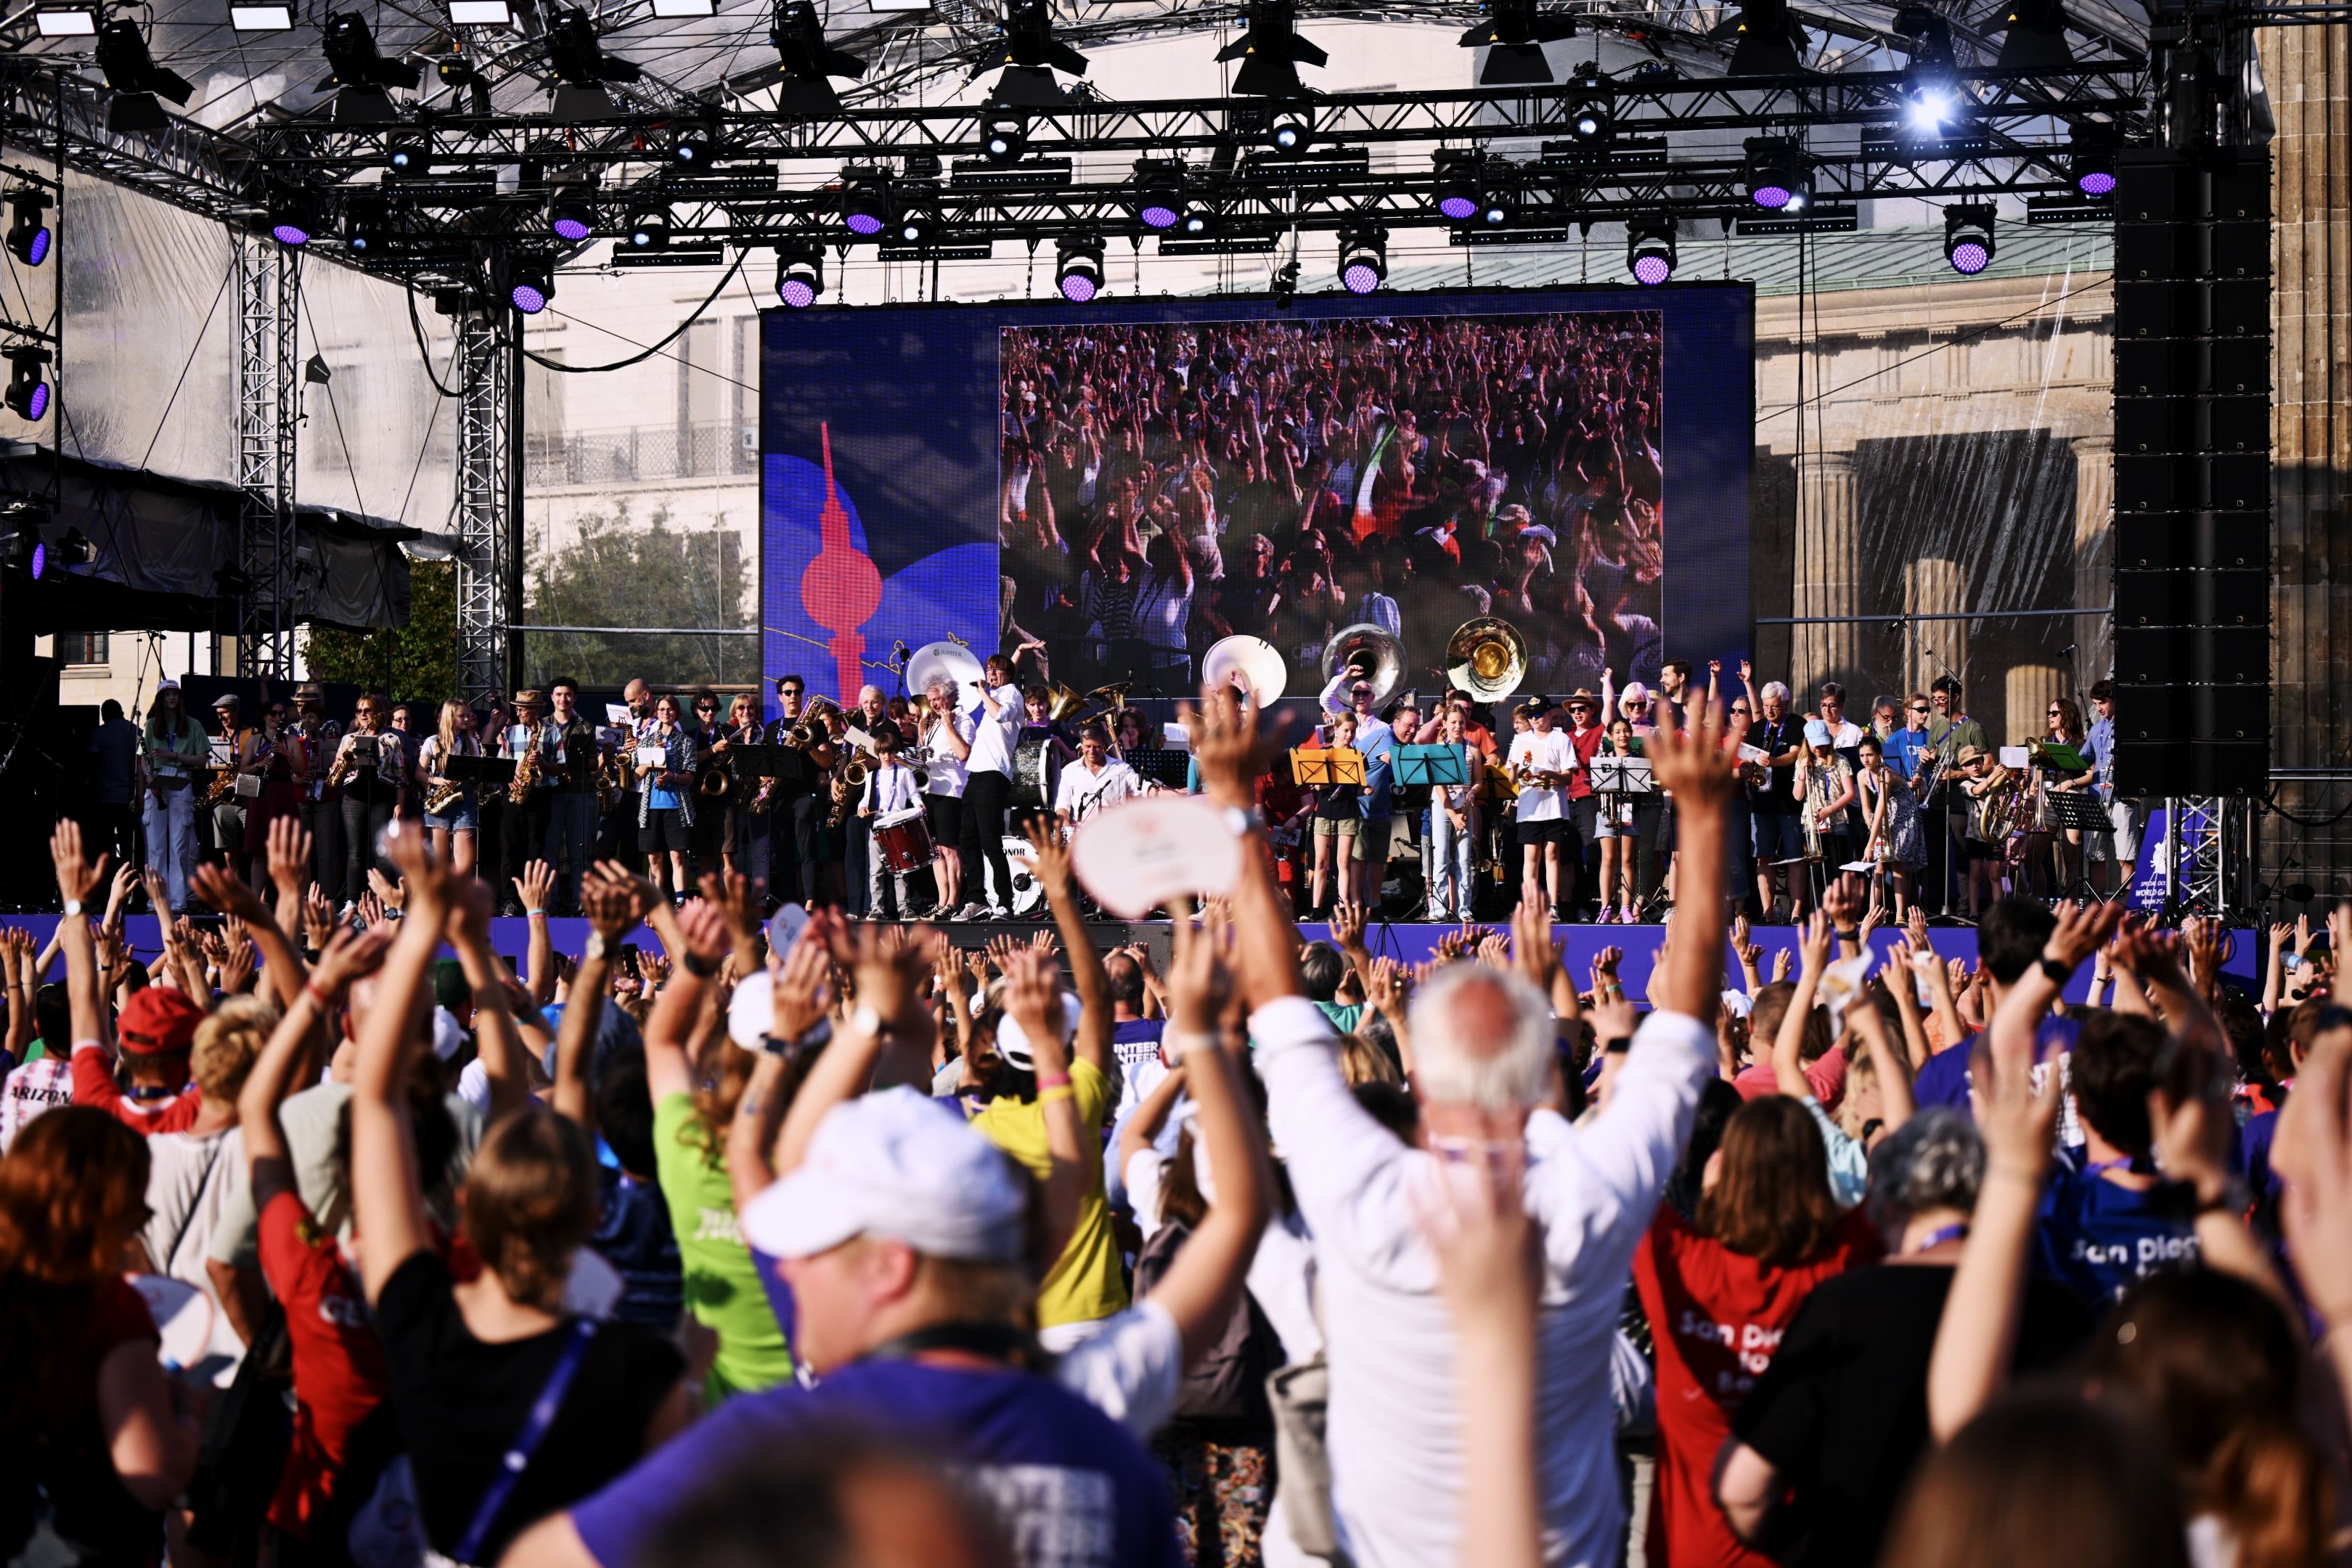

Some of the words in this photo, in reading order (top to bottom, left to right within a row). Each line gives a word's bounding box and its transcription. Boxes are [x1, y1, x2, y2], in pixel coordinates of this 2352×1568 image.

[1003, 848, 1025, 857] ONOR
[10, 1086, 73, 1104] ARIZON
[2071, 1238, 2128, 1264] San
[1679, 1310, 1735, 1347] San
